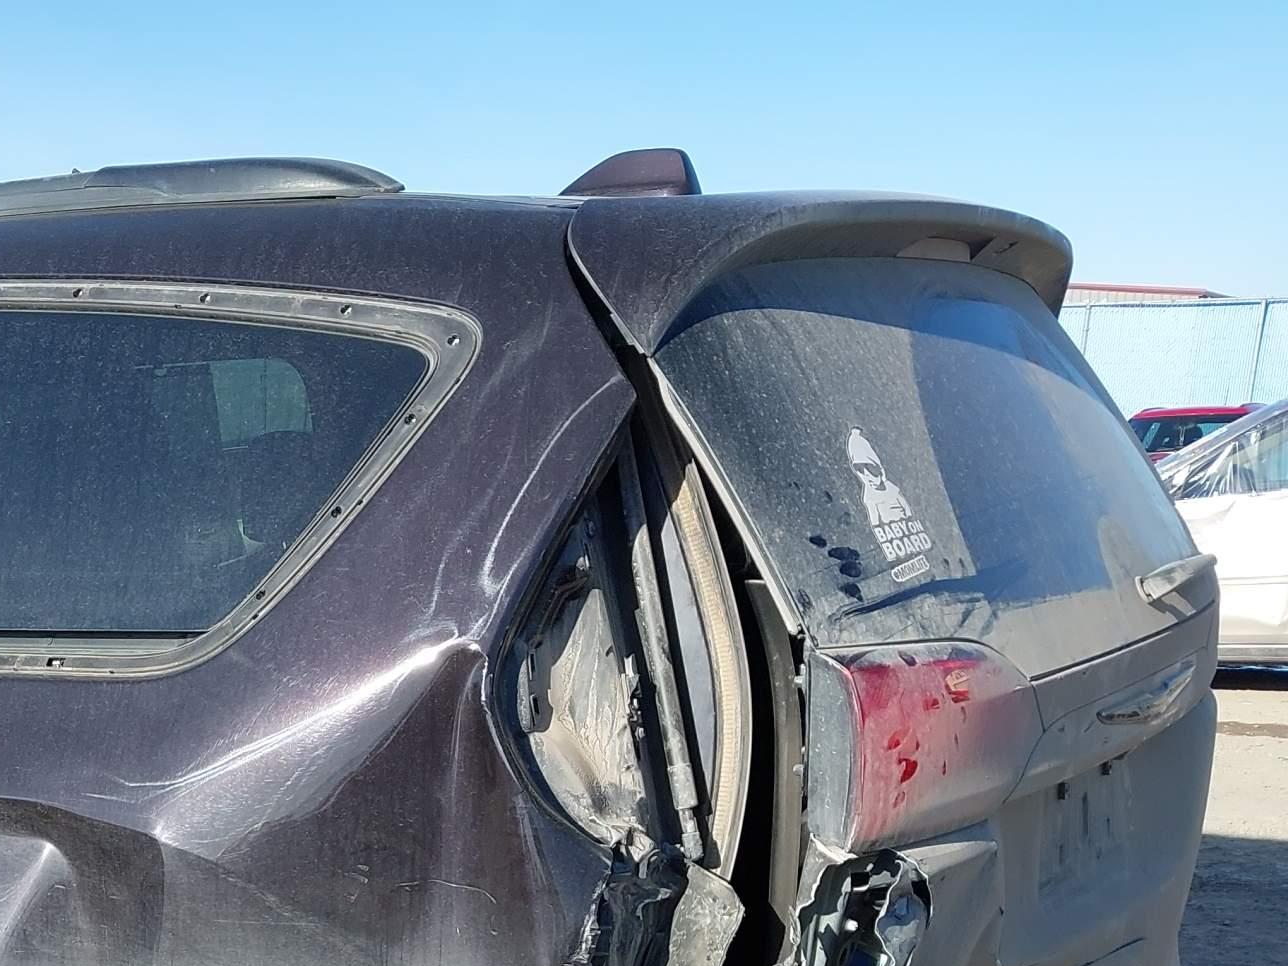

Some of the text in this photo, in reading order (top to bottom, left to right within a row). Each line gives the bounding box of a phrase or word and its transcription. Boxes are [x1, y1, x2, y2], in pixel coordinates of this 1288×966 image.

[874, 519, 924, 543] BABY ON
[881, 532, 932, 562] BOARD
